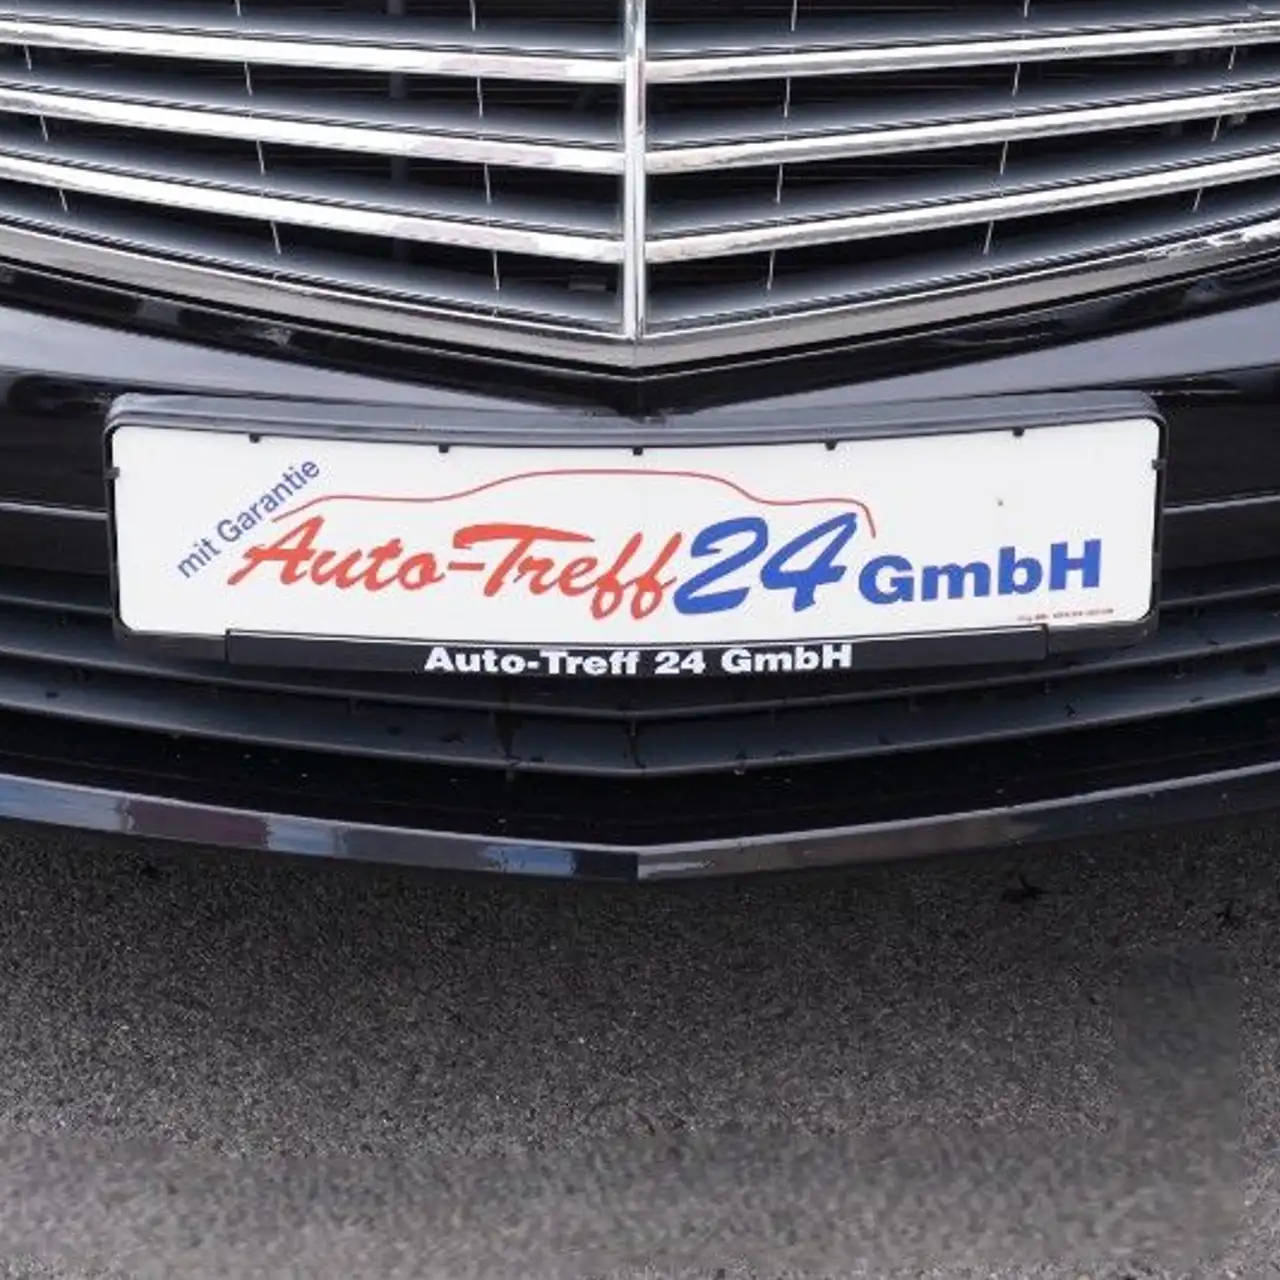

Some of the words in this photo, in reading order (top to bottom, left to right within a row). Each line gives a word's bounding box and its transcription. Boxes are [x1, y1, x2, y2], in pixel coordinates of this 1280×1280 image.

[177, 539, 222, 579] mit
[217, 461, 321, 543] Garantie
[858, 539, 1102, 605] GmbH
[424, 646, 640, 675] Auto-Treff
[654, 650, 707, 675] 24
[721, 644, 852, 673] GmbH
